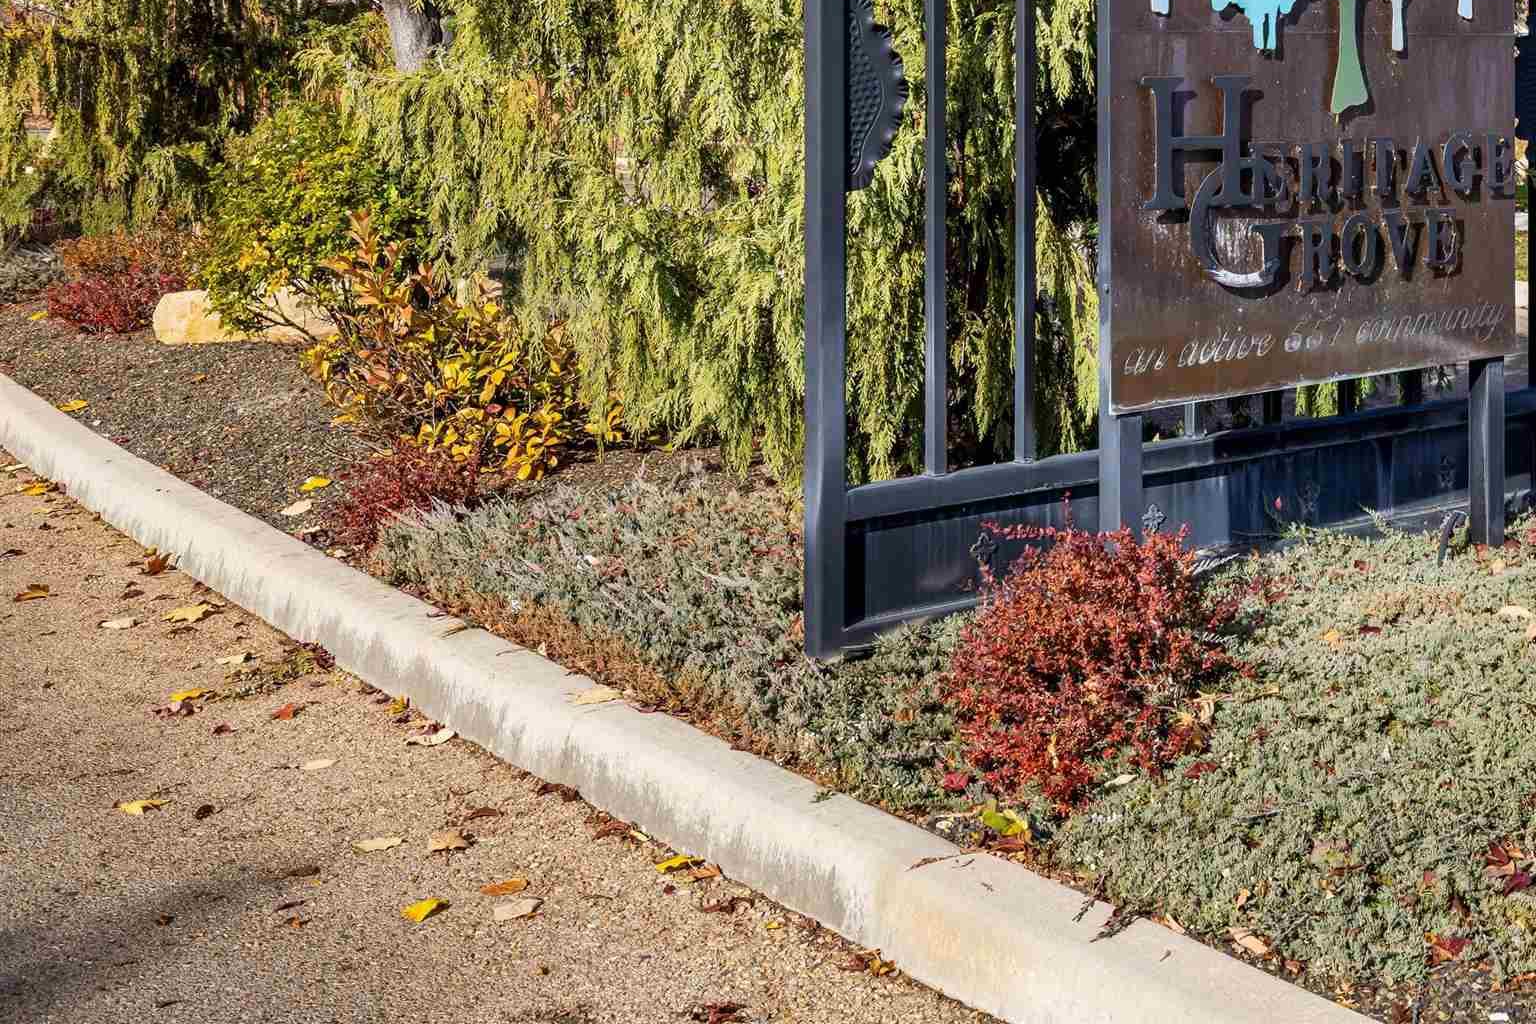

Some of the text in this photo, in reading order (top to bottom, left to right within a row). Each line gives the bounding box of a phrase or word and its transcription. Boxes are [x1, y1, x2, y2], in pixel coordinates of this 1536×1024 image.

[1141, 75, 1514, 209] HERITAGE
[1189, 160, 1457, 288] GROVE
[1124, 346, 1169, 375] an
[1177, 326, 1275, 367] active
[1355, 301, 1504, 344] community
